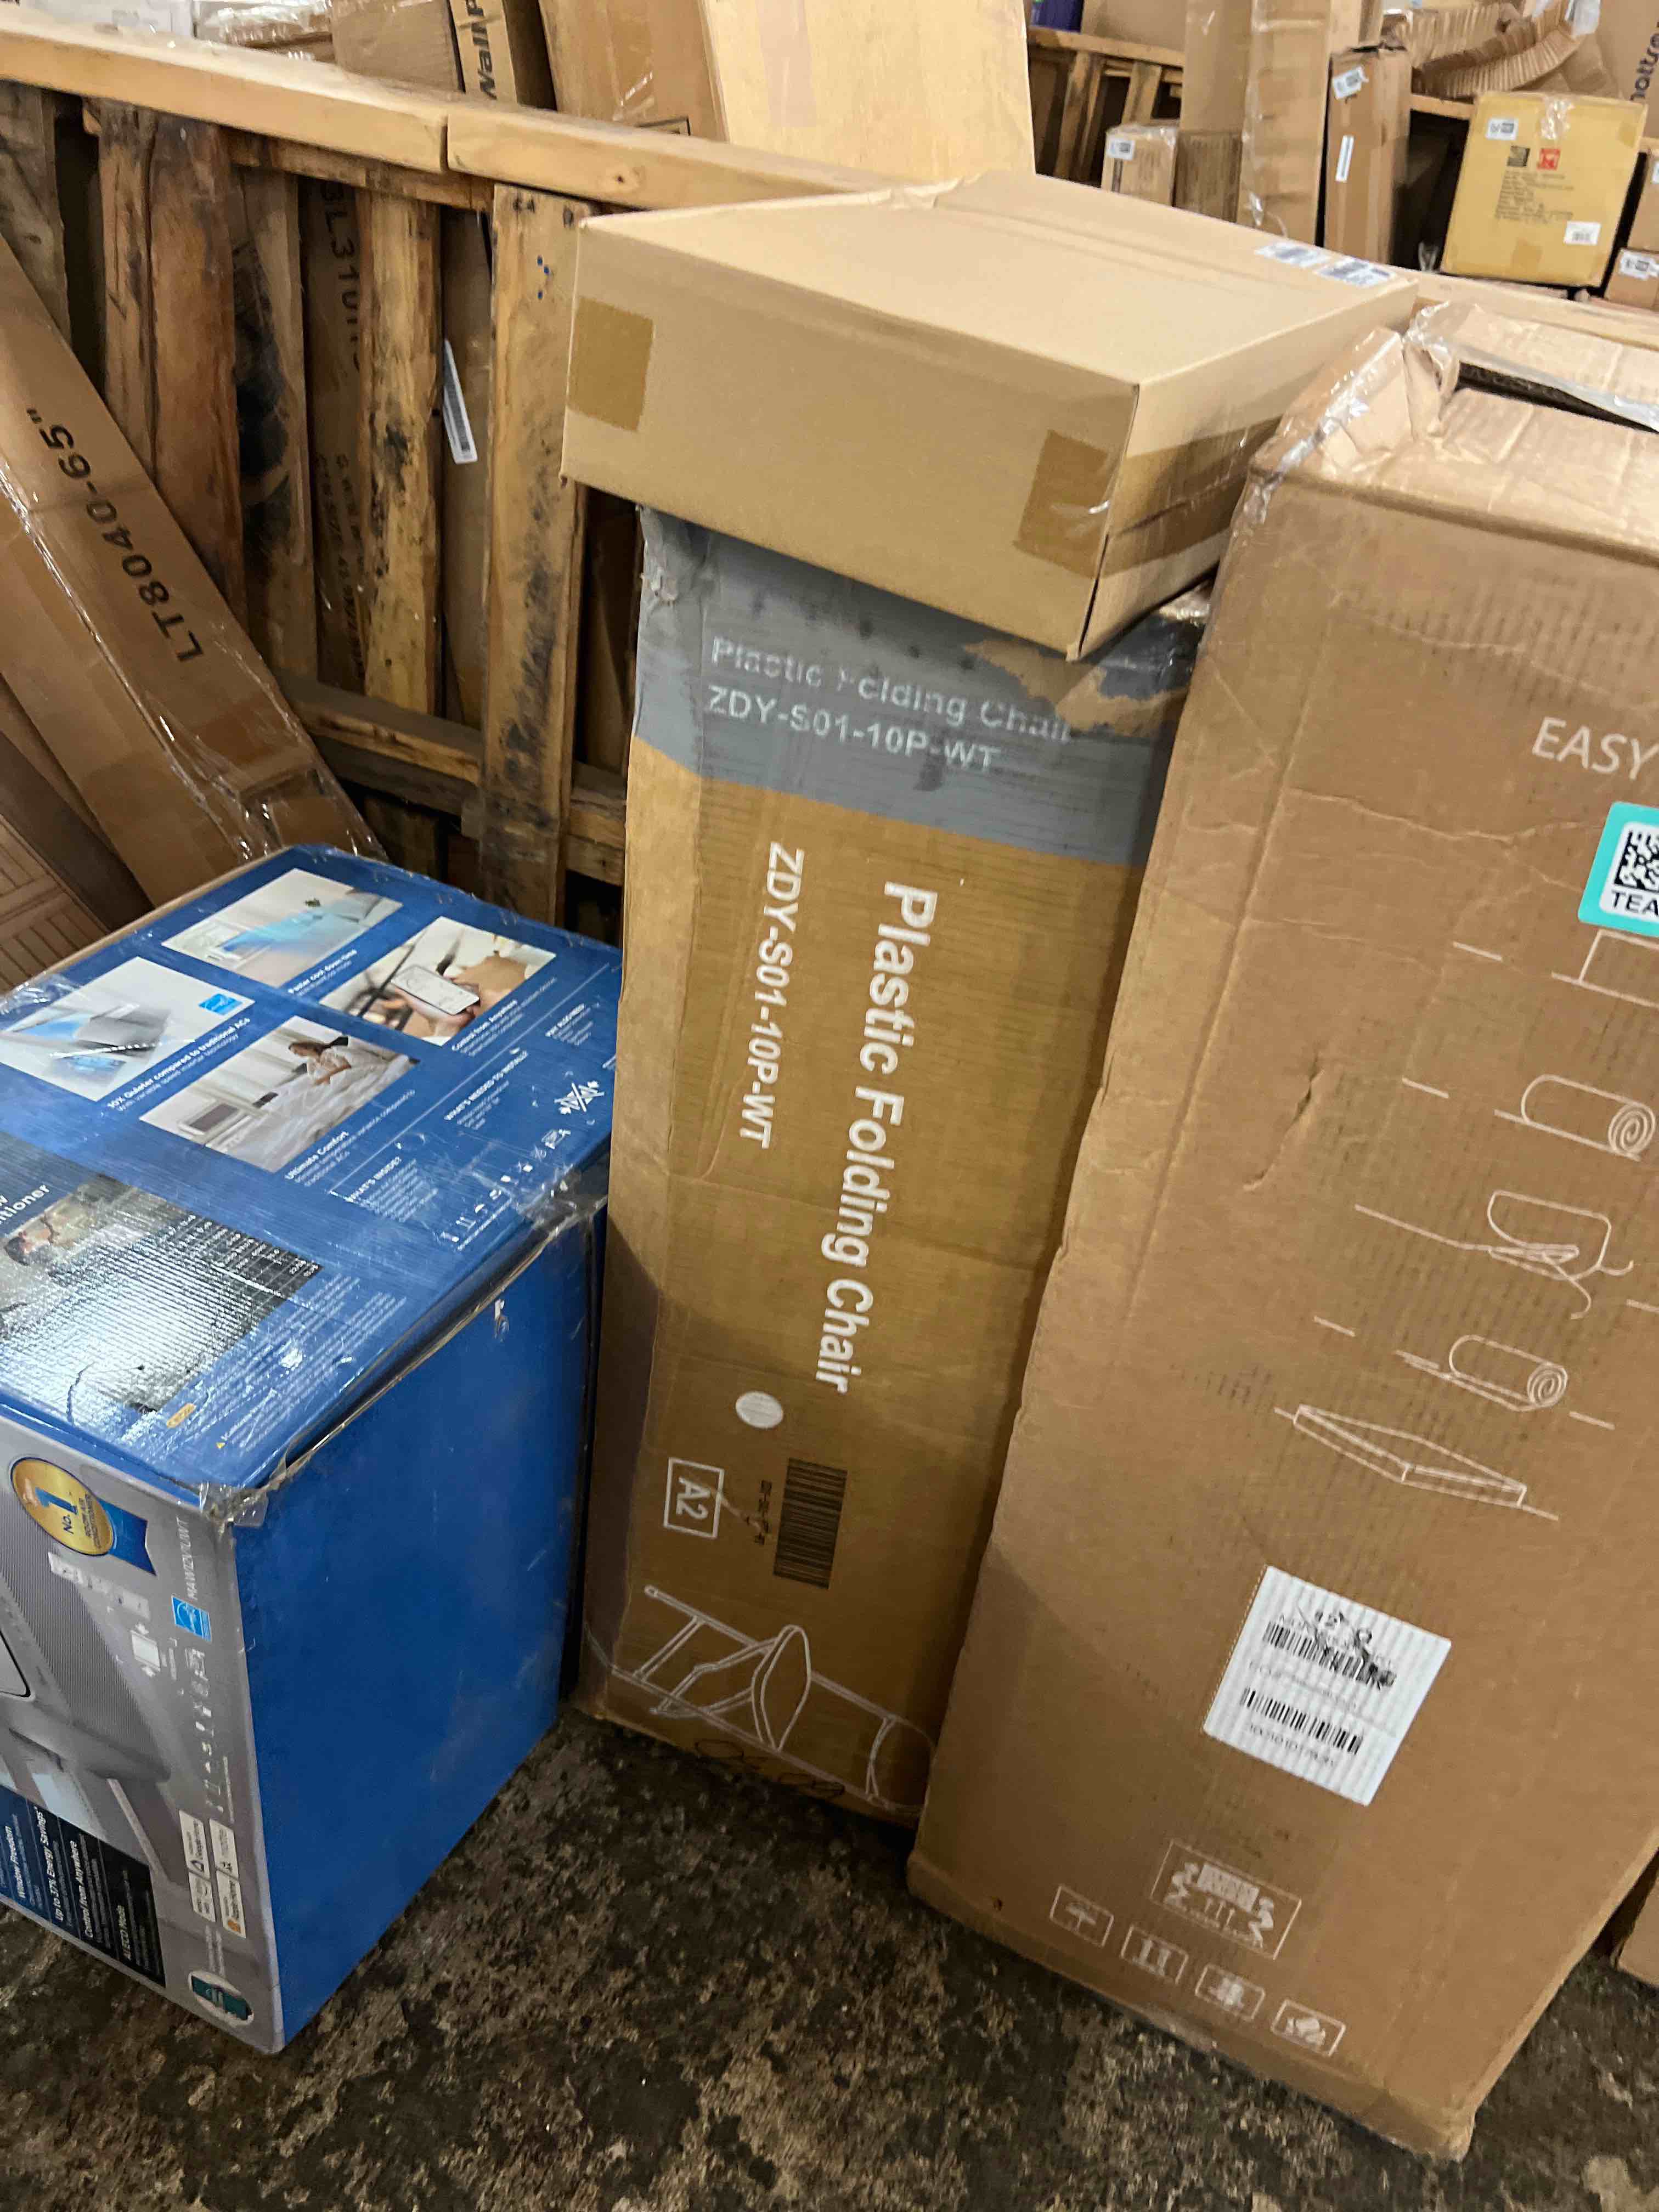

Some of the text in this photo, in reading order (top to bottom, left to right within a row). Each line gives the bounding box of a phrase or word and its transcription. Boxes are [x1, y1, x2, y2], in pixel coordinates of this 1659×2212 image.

[26, 407, 204, 663] LT8040-65"
[705, 684, 1002, 772] ZDY-S01-10P-WT
[1532, 716, 1659, 781] EASY
[738, 840, 805, 1149] ZDY-S01-10P-WT
[815, 881, 938, 1395] Plastic Folding Chair
[34, 1487, 78, 1515] 1
[675, 1476, 710, 1521] A2
